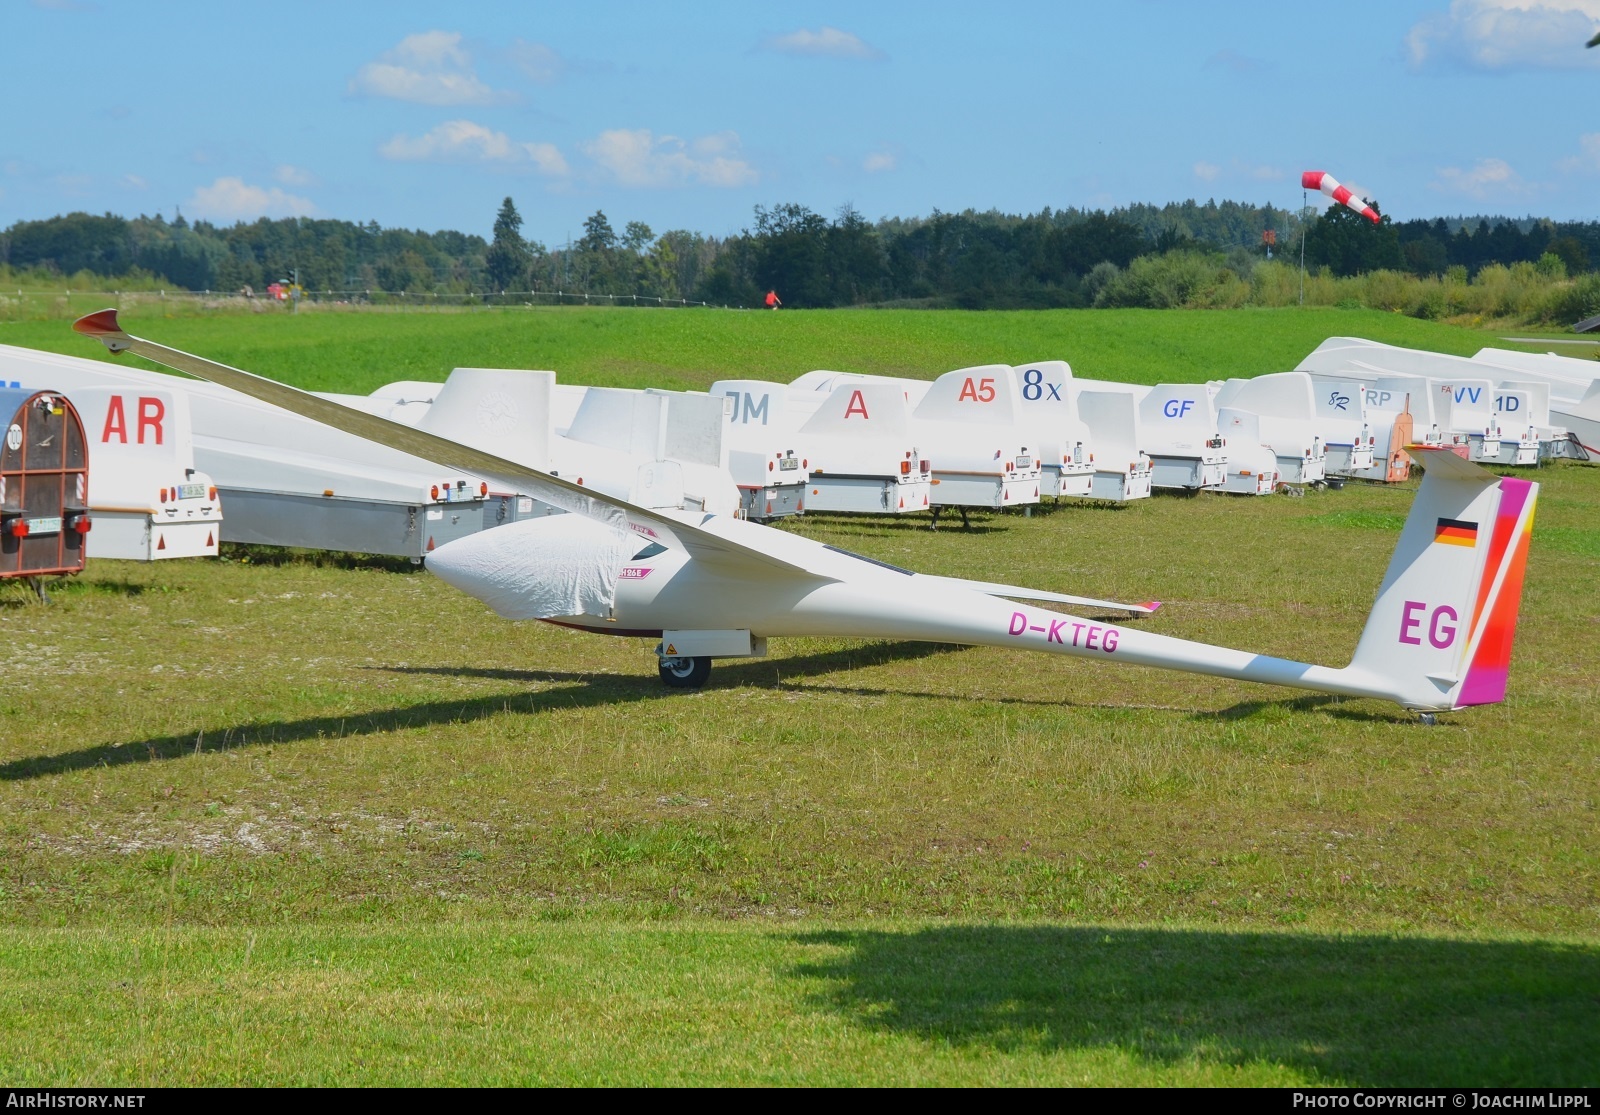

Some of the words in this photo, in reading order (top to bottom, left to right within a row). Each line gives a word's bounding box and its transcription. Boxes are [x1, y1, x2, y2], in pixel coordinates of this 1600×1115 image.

[958, 377, 996, 402] A5
[1328, 391, 1350, 411] 8R
[1365, 390, 1392, 406] RP
[725, 391, 769, 426] JM
[844, 390, 869, 419] A
[1163, 399, 1195, 418] GF
[1495, 395, 1520, 412] 1D
[102, 395, 165, 445] AR
[1008, 611, 1120, 653] D-KTEG
[1398, 600, 1458, 650] EG
